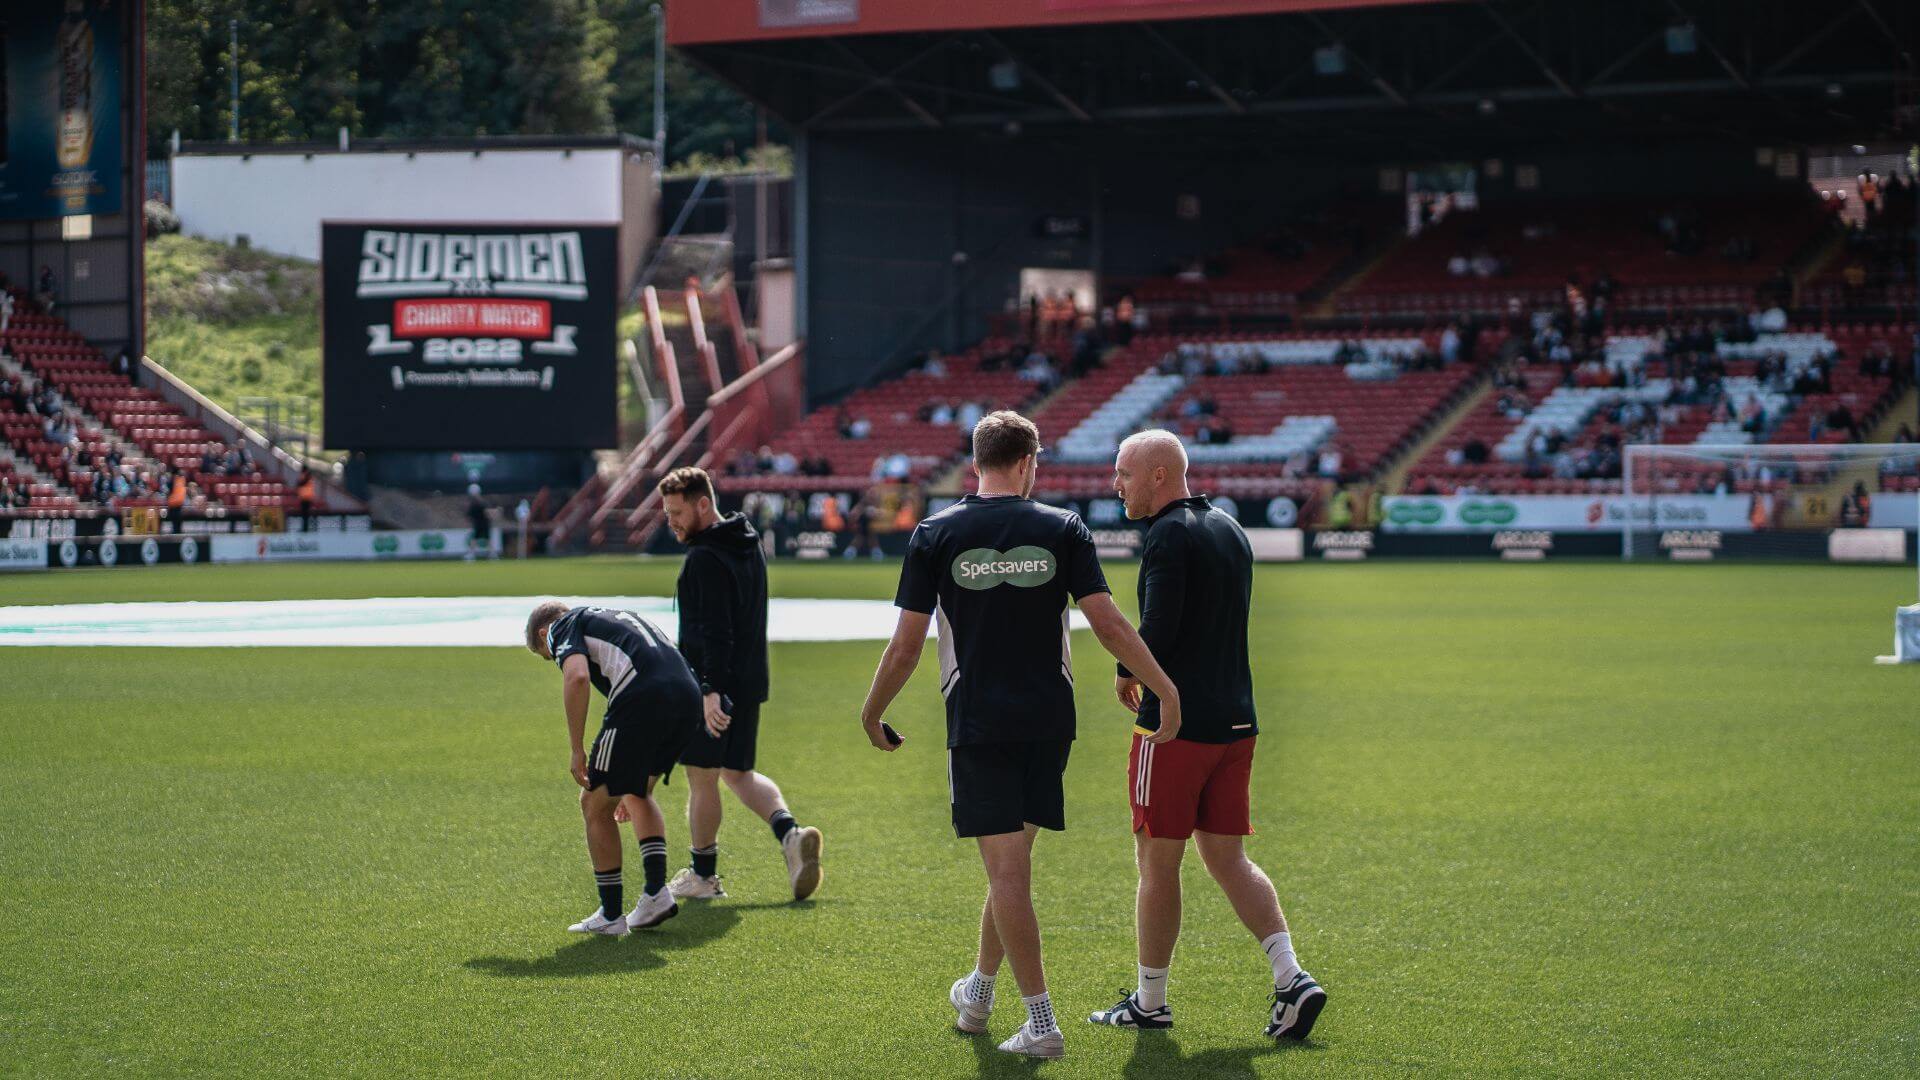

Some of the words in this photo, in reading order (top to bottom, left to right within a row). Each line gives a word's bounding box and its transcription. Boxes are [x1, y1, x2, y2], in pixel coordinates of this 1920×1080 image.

[358, 230, 587, 283] SIDEMEN
[403, 303, 476, 328] CHARITY
[480, 303, 543, 328] MATCH
[423, 338, 522, 364] 2022
[1314, 530, 1373, 549] ARCADE
[1492, 530, 1552, 549] ARCADE
[1660, 530, 1721, 549] ARCADE
[960, 560, 1048, 579] Specsavers
